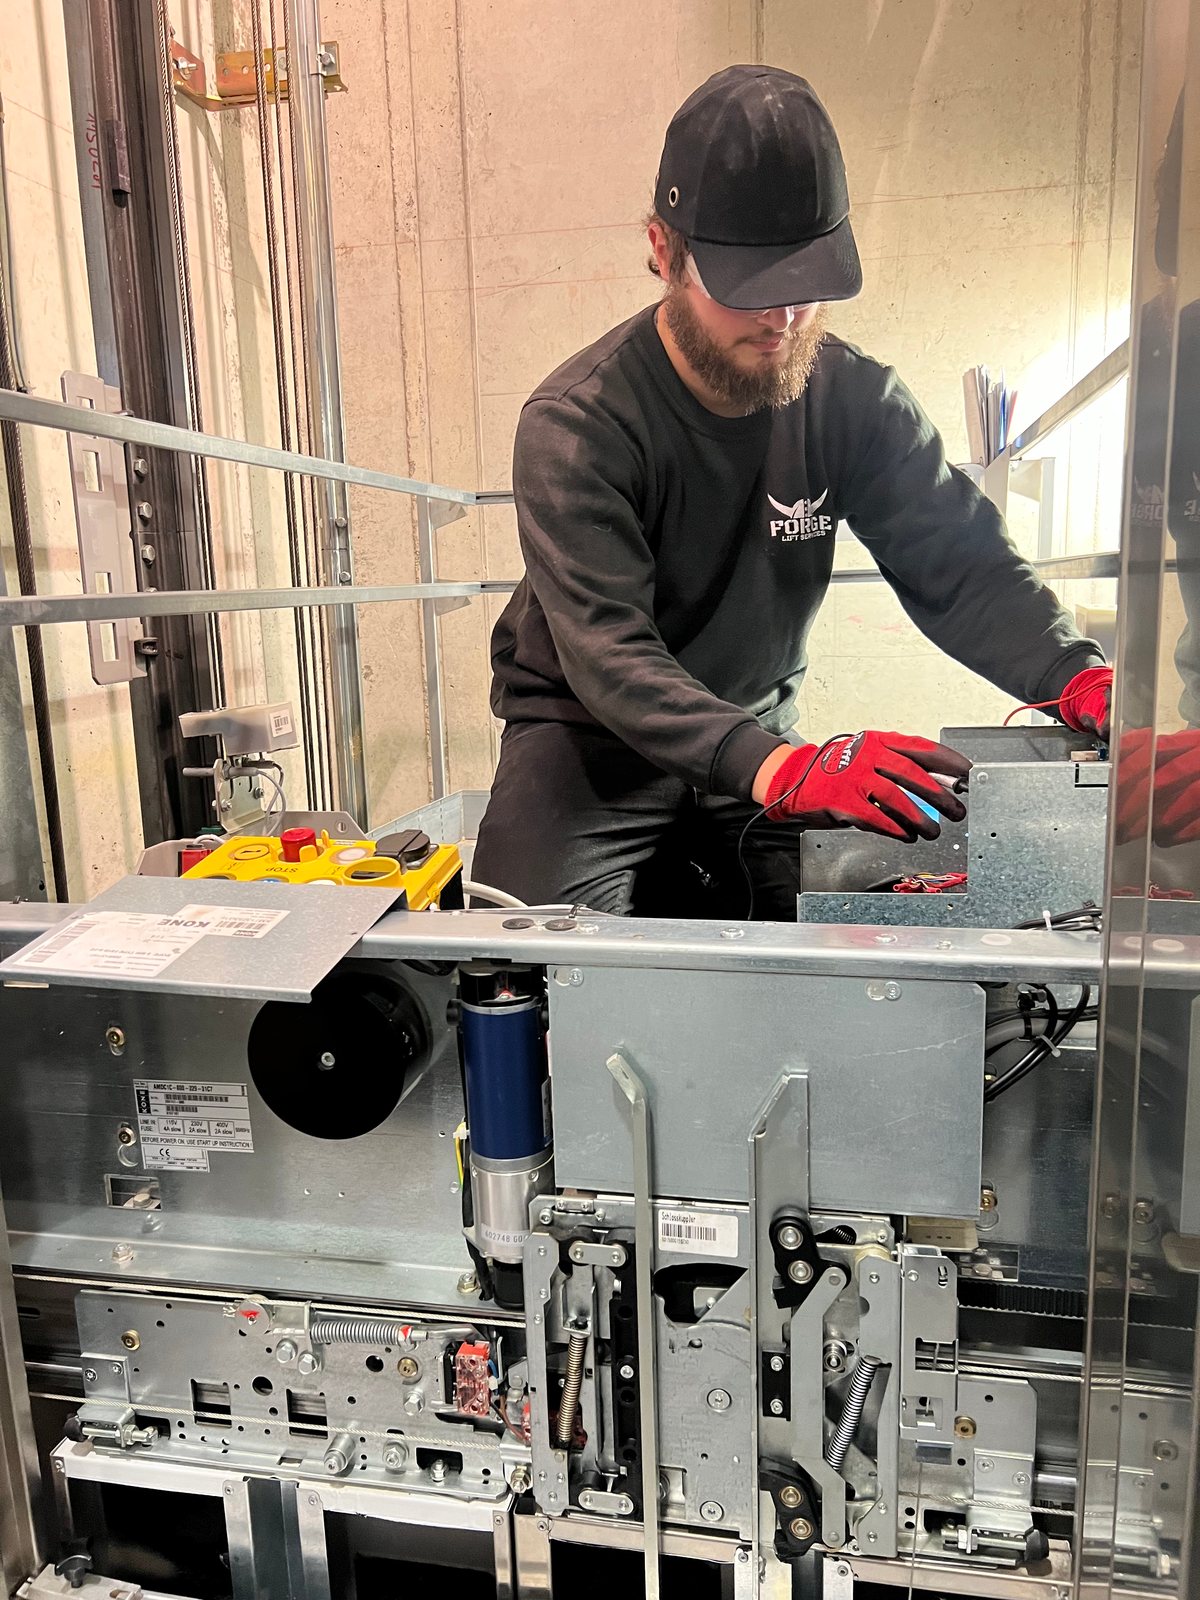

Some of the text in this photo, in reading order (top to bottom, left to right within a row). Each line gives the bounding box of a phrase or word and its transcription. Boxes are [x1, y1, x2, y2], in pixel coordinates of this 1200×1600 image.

[769, 514, 832, 537] FORGE
[781, 534, 800, 542] LIFT
[157, 919, 211, 928] KONE
